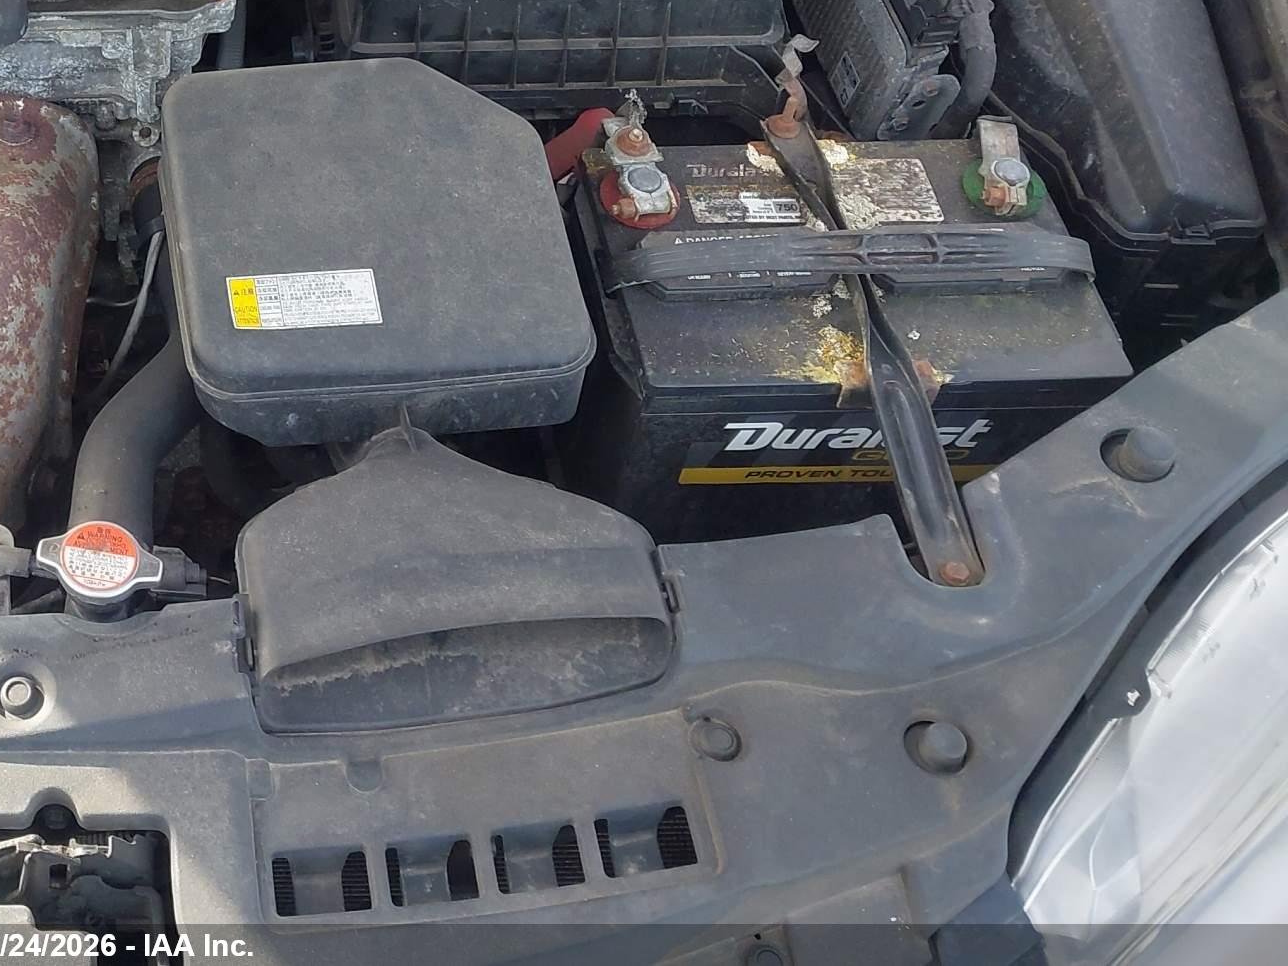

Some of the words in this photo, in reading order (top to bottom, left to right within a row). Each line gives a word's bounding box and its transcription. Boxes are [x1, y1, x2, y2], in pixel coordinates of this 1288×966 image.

[775, 203, 799, 212] 750
[723, 419, 992, 451] Duralst
[744, 469, 843, 480] PROVEN
